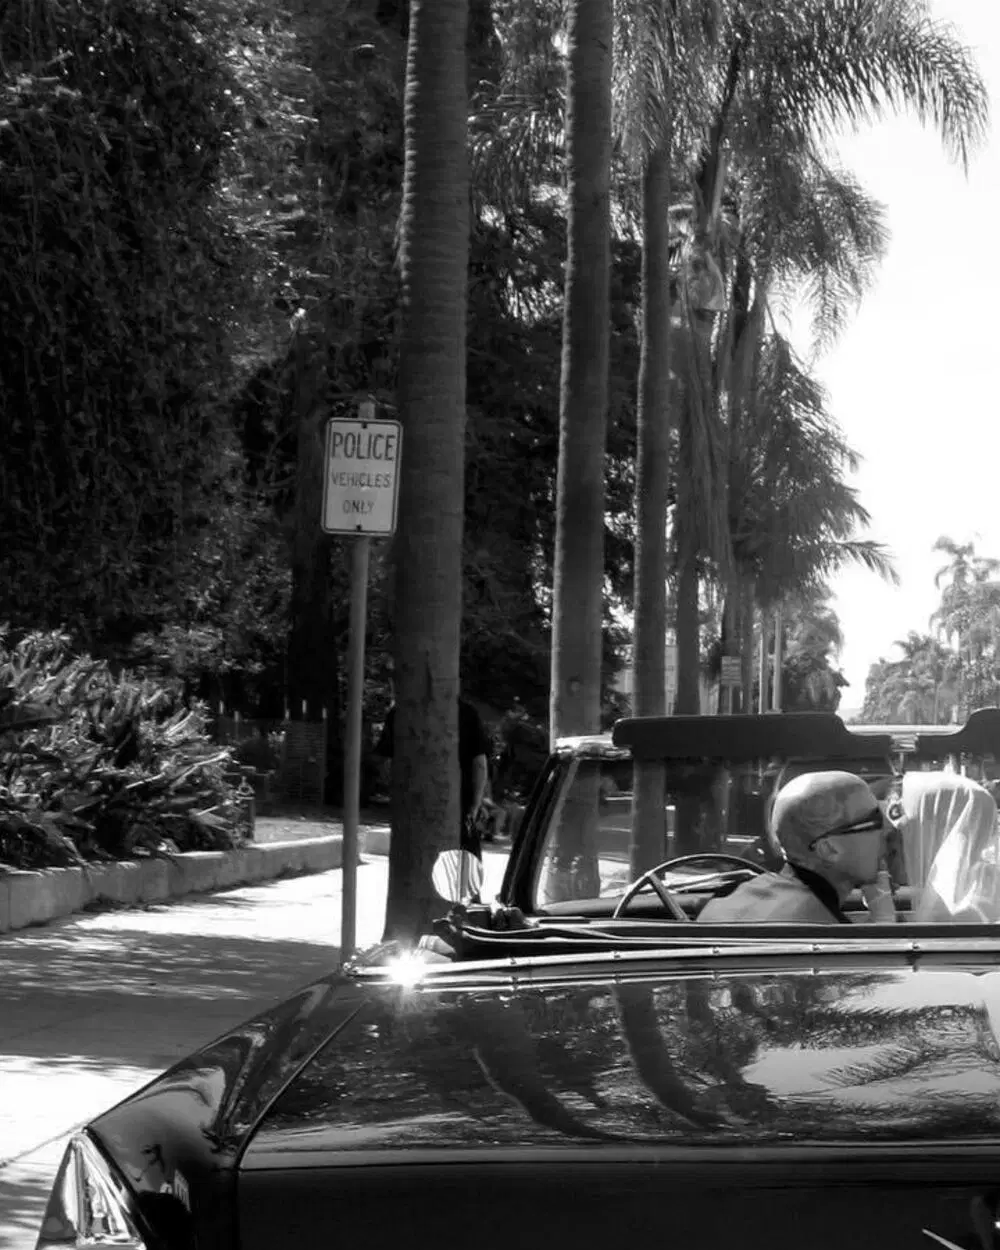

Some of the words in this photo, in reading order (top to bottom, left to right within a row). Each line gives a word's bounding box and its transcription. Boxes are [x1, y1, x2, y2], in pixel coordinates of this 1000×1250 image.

[331, 431, 396, 461] POLICE
[331, 471, 392, 488] VEHICLES
[342, 499, 375, 514] ONLY
